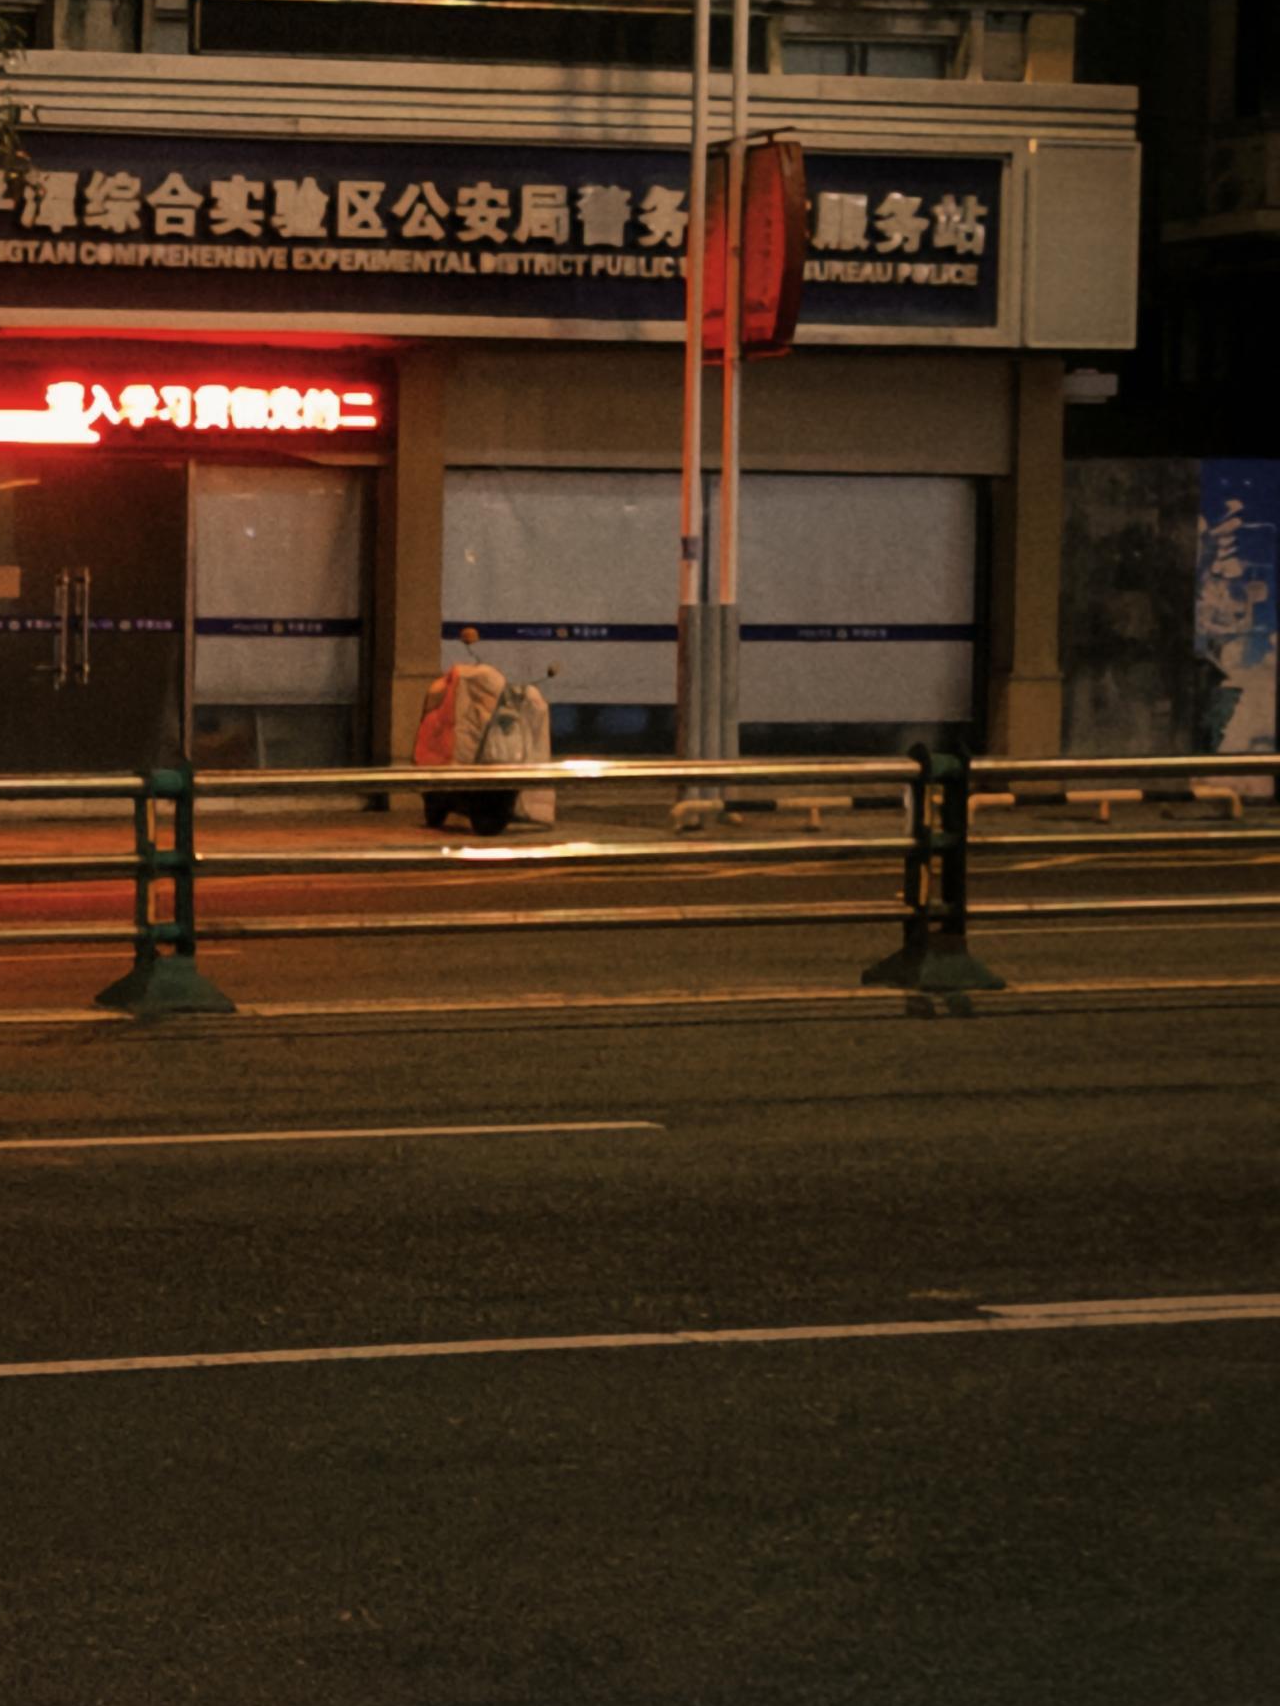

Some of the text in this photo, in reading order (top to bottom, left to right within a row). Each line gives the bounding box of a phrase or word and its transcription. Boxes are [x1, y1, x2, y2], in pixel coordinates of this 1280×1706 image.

[80, 242, 287, 269] COMPREHENSIVE
[292, 247, 475, 274] EXPERIMENTAL
[480, 251, 586, 276] DISTRICT
[591, 254, 676, 278] PUBLIC
[897, 263, 978, 286] POLICE
